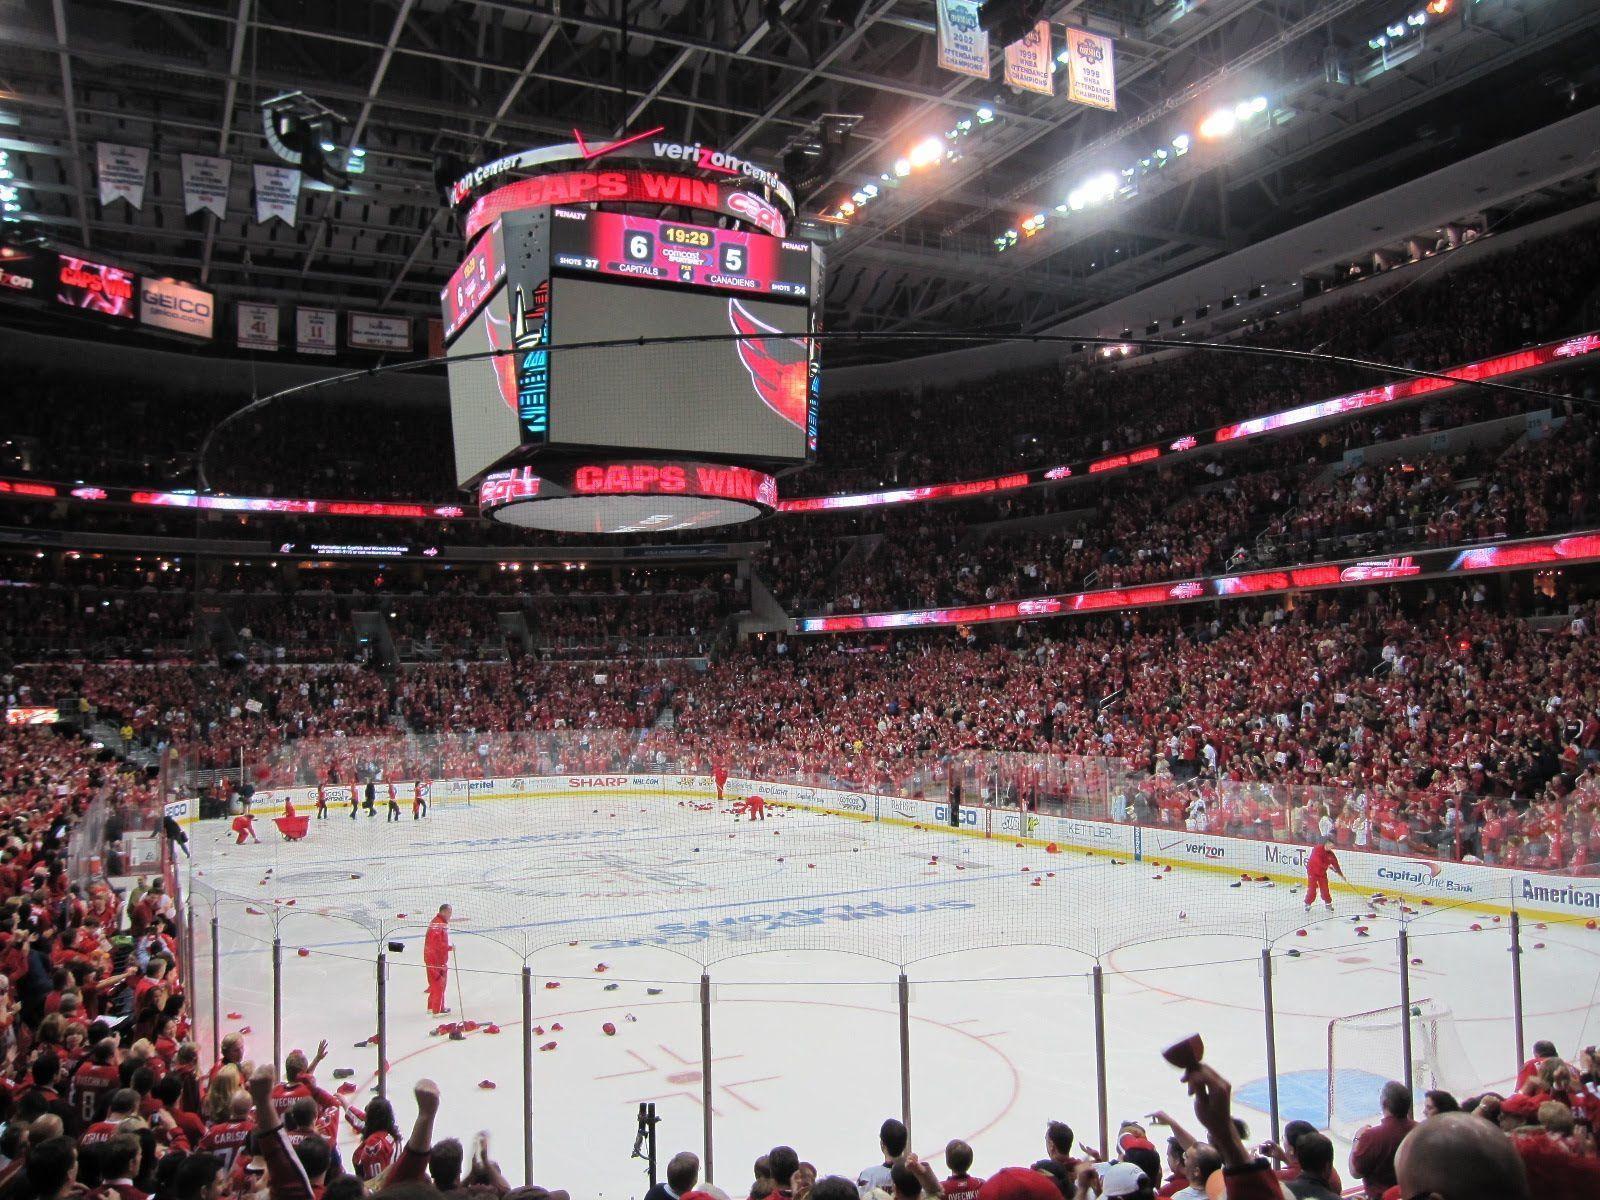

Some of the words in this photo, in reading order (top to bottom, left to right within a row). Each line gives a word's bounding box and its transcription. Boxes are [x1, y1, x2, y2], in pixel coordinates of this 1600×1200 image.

[953, 32, 974, 44] 2002
[653, 142, 741, 174] verizon
[520, 173, 628, 202] CAPS
[641, 173, 719, 208] WIN
[555, 209, 587, 221] PENALTY
[666, 228, 709, 246] 19:29
[630, 235, 648, 259] 6
[781, 241, 809, 252] PENALTY
[559, 256, 582, 266] SHOTS
[585, 259, 599, 269] 37
[725, 248, 742, 271] 5
[619, 263, 659, 276] CAPITALS
[682, 272, 691, 281] 4
[710, 275, 755, 288] CANADIENS
[771, 283, 791, 292] SHOTS
[794, 286, 806, 295] 24
[142, 289, 210, 317] GEICO
[576, 466, 686, 494] CAPS
[697, 467, 755, 500] WIN
[569, 777, 628, 793] SHARP
[935, 806, 977, 826] GCO
[1068, 823, 1112, 838] KETTLER
[1186, 842, 1225, 859] verizon
[1265, 844, 1309, 867] MicroTe
[1377, 867, 1422, 884] Capital
[1446, 880, 1473, 893] Bank
[82, 1091, 95, 1121] 8
[214, 1130, 248, 1144] CARLSO
